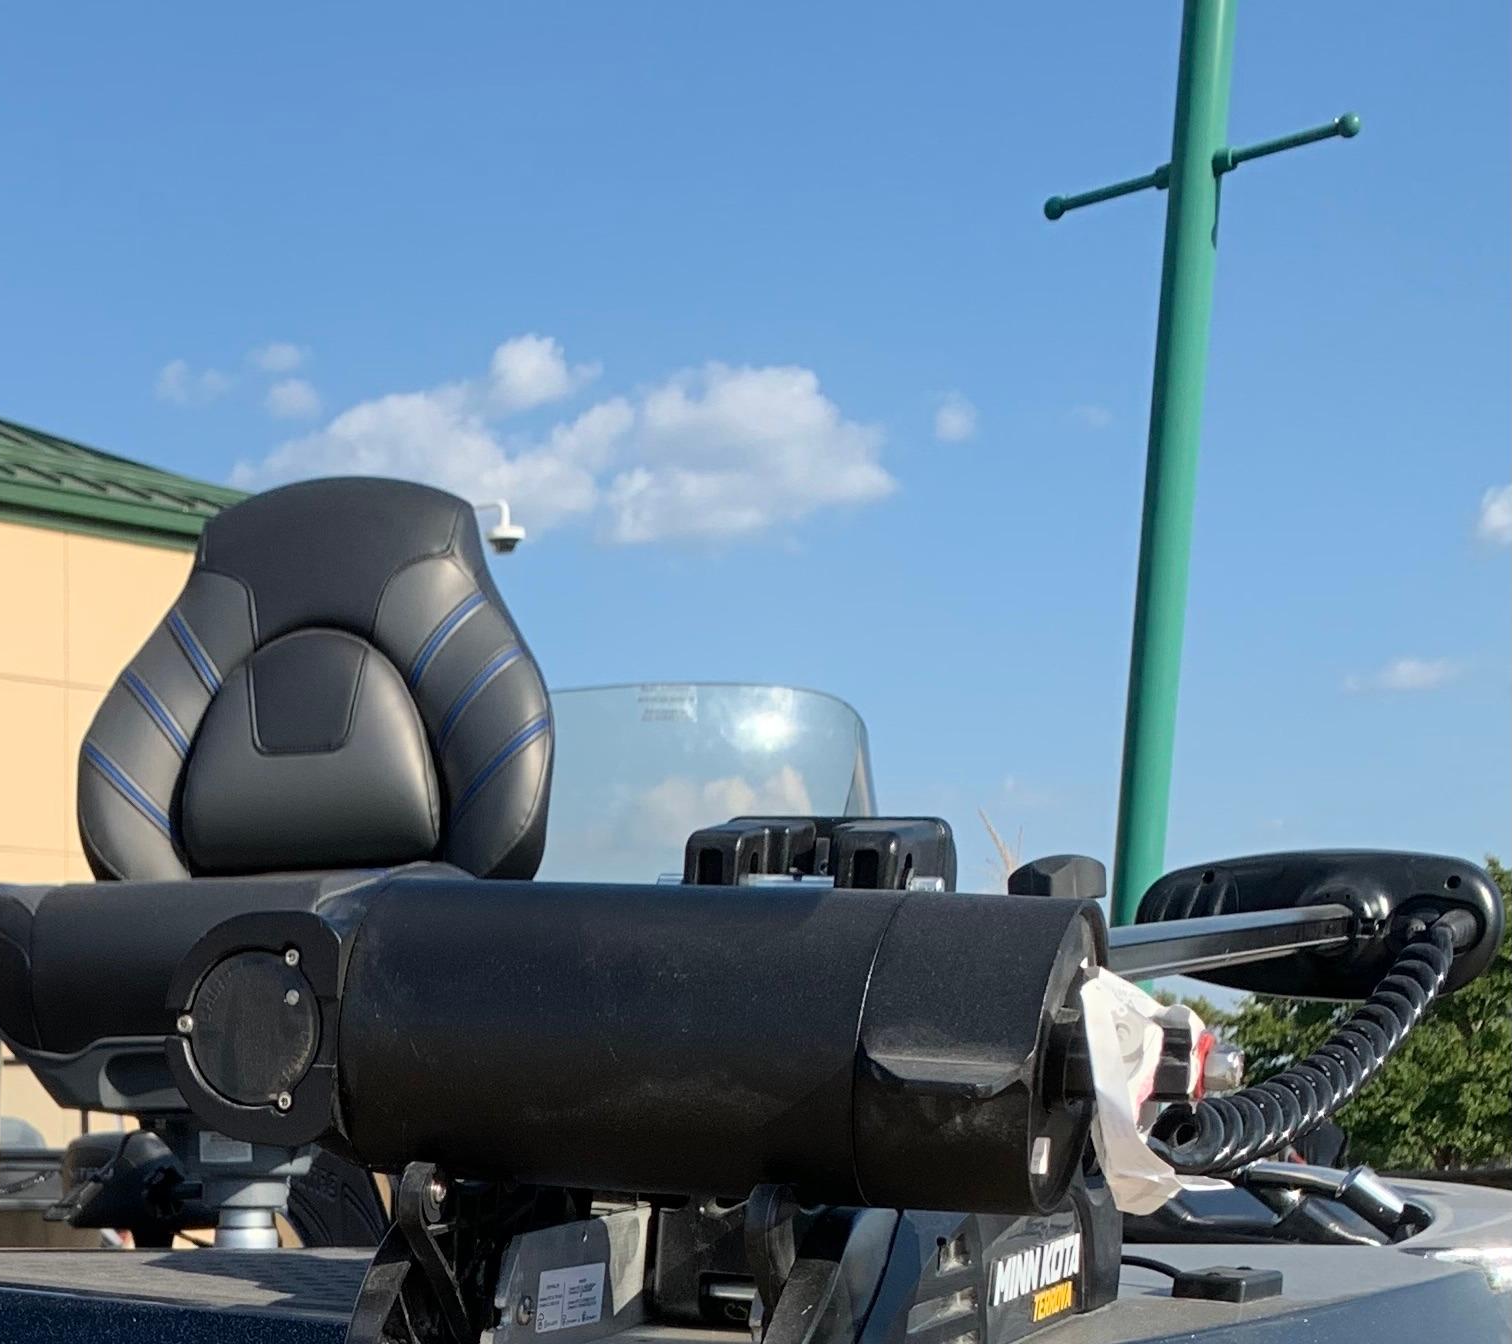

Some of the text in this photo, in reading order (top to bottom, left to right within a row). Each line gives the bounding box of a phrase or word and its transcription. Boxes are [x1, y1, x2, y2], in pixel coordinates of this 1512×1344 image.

[993, 1232, 1081, 1307] MINN KOTA
[1032, 1281, 1073, 1323] TERROVA
